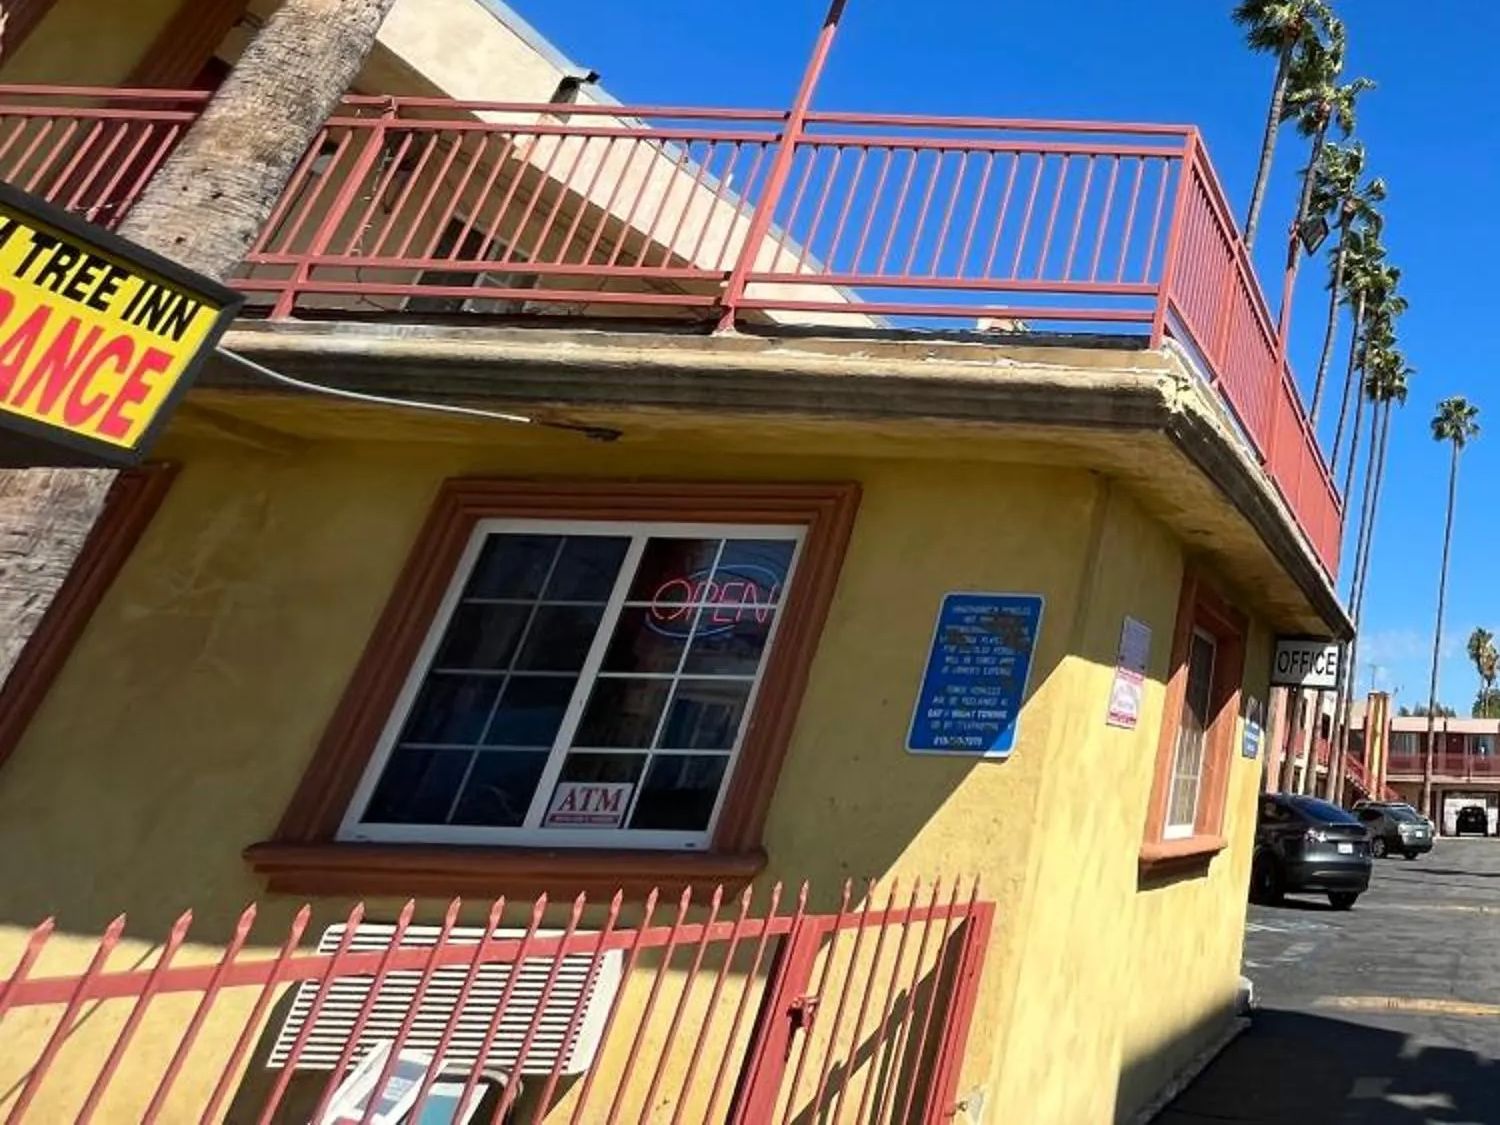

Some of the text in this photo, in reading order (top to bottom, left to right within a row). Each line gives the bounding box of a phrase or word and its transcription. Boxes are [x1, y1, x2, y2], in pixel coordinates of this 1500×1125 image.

[13, 230, 131, 311] TREE
[120, 278, 201, 342] INN
[0, 286, 176, 440] ANCE
[651, 578, 778, 623] OPEN
[1278, 650, 1336, 675] OFFICE
[557, 787, 624, 812] ATM
